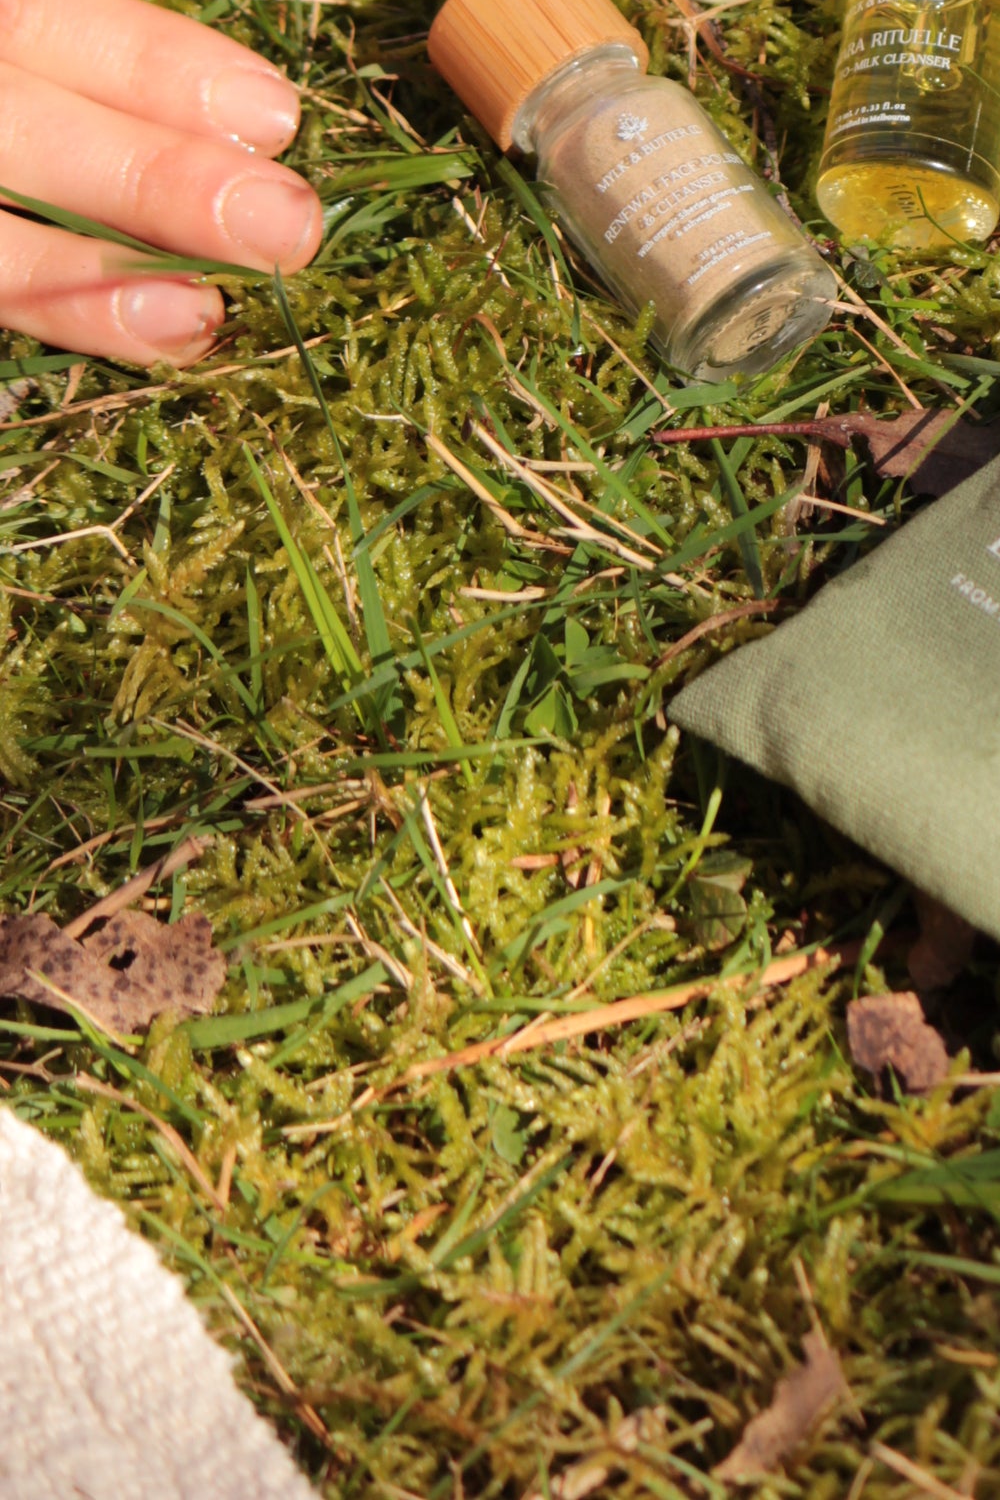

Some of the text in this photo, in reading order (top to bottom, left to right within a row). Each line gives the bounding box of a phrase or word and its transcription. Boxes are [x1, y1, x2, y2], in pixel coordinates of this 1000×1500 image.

[871, 28, 963, 52] RITUELLE
[883, 52, 952, 70] CLEANSER
[596, 163, 630, 194] MYLK
[630, 153, 641, 164] &
[604, 185, 658, 243] RENEWAL
[660, 160, 699, 188] FACE
[642, 171, 728, 227] & CLEANSER
[949, 572, 1000, 615] FROM
